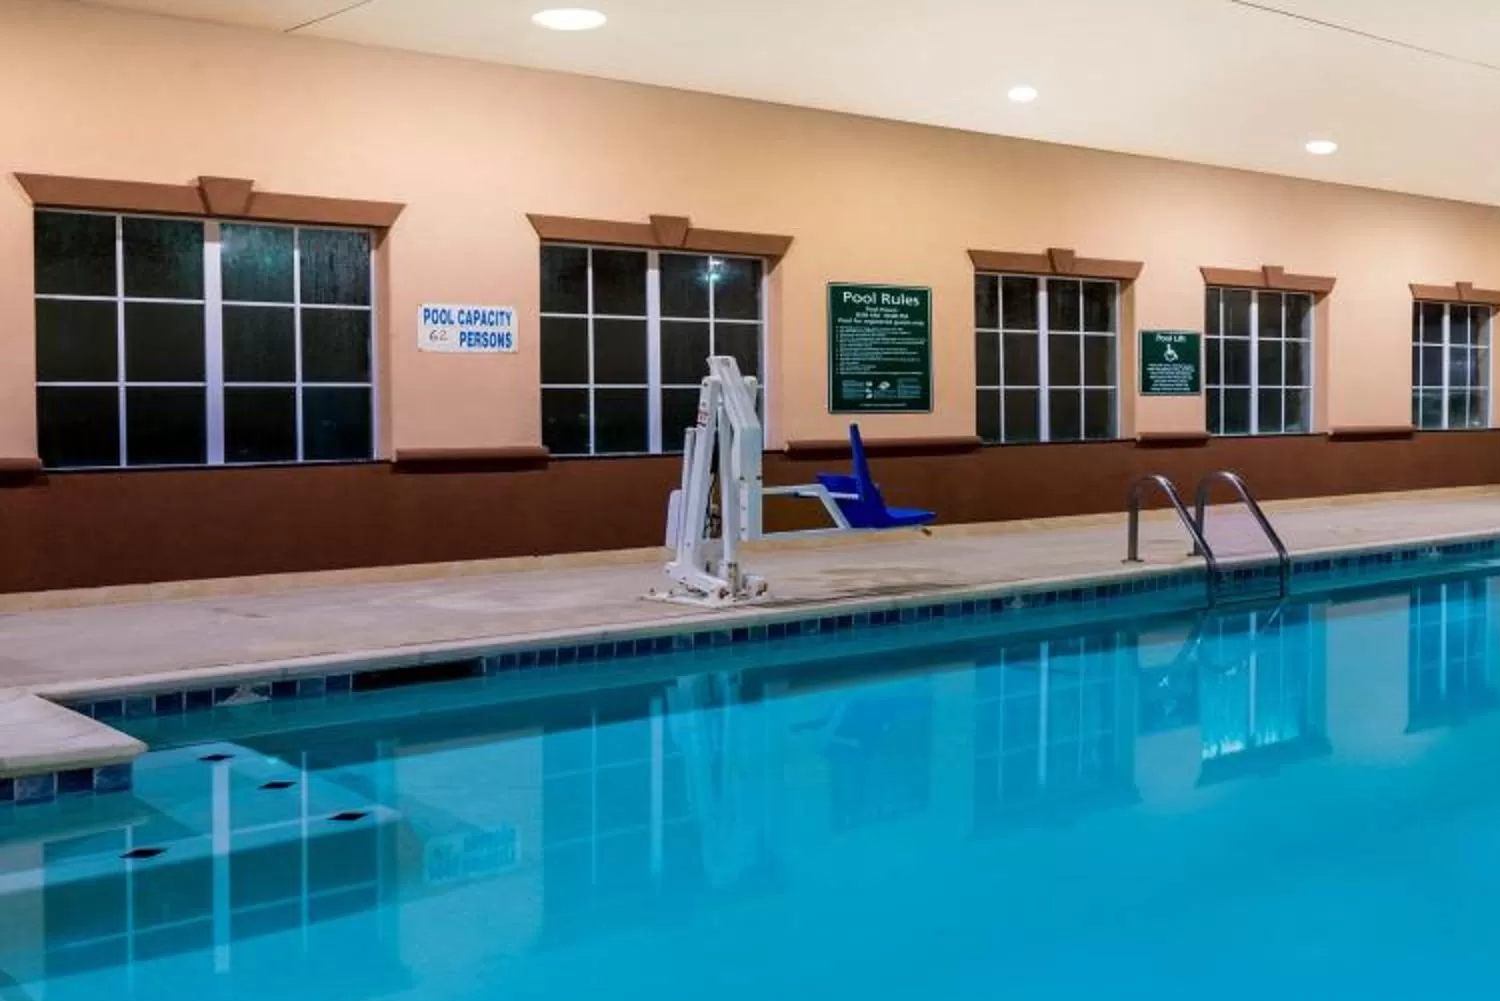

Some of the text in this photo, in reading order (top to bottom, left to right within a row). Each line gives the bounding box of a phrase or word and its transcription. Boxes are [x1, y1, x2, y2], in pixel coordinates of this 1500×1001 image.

[843, 291, 920, 307] Pool Rules
[423, 307, 513, 327] POOL CAPACITY
[459, 331, 513, 348] PERSONS
